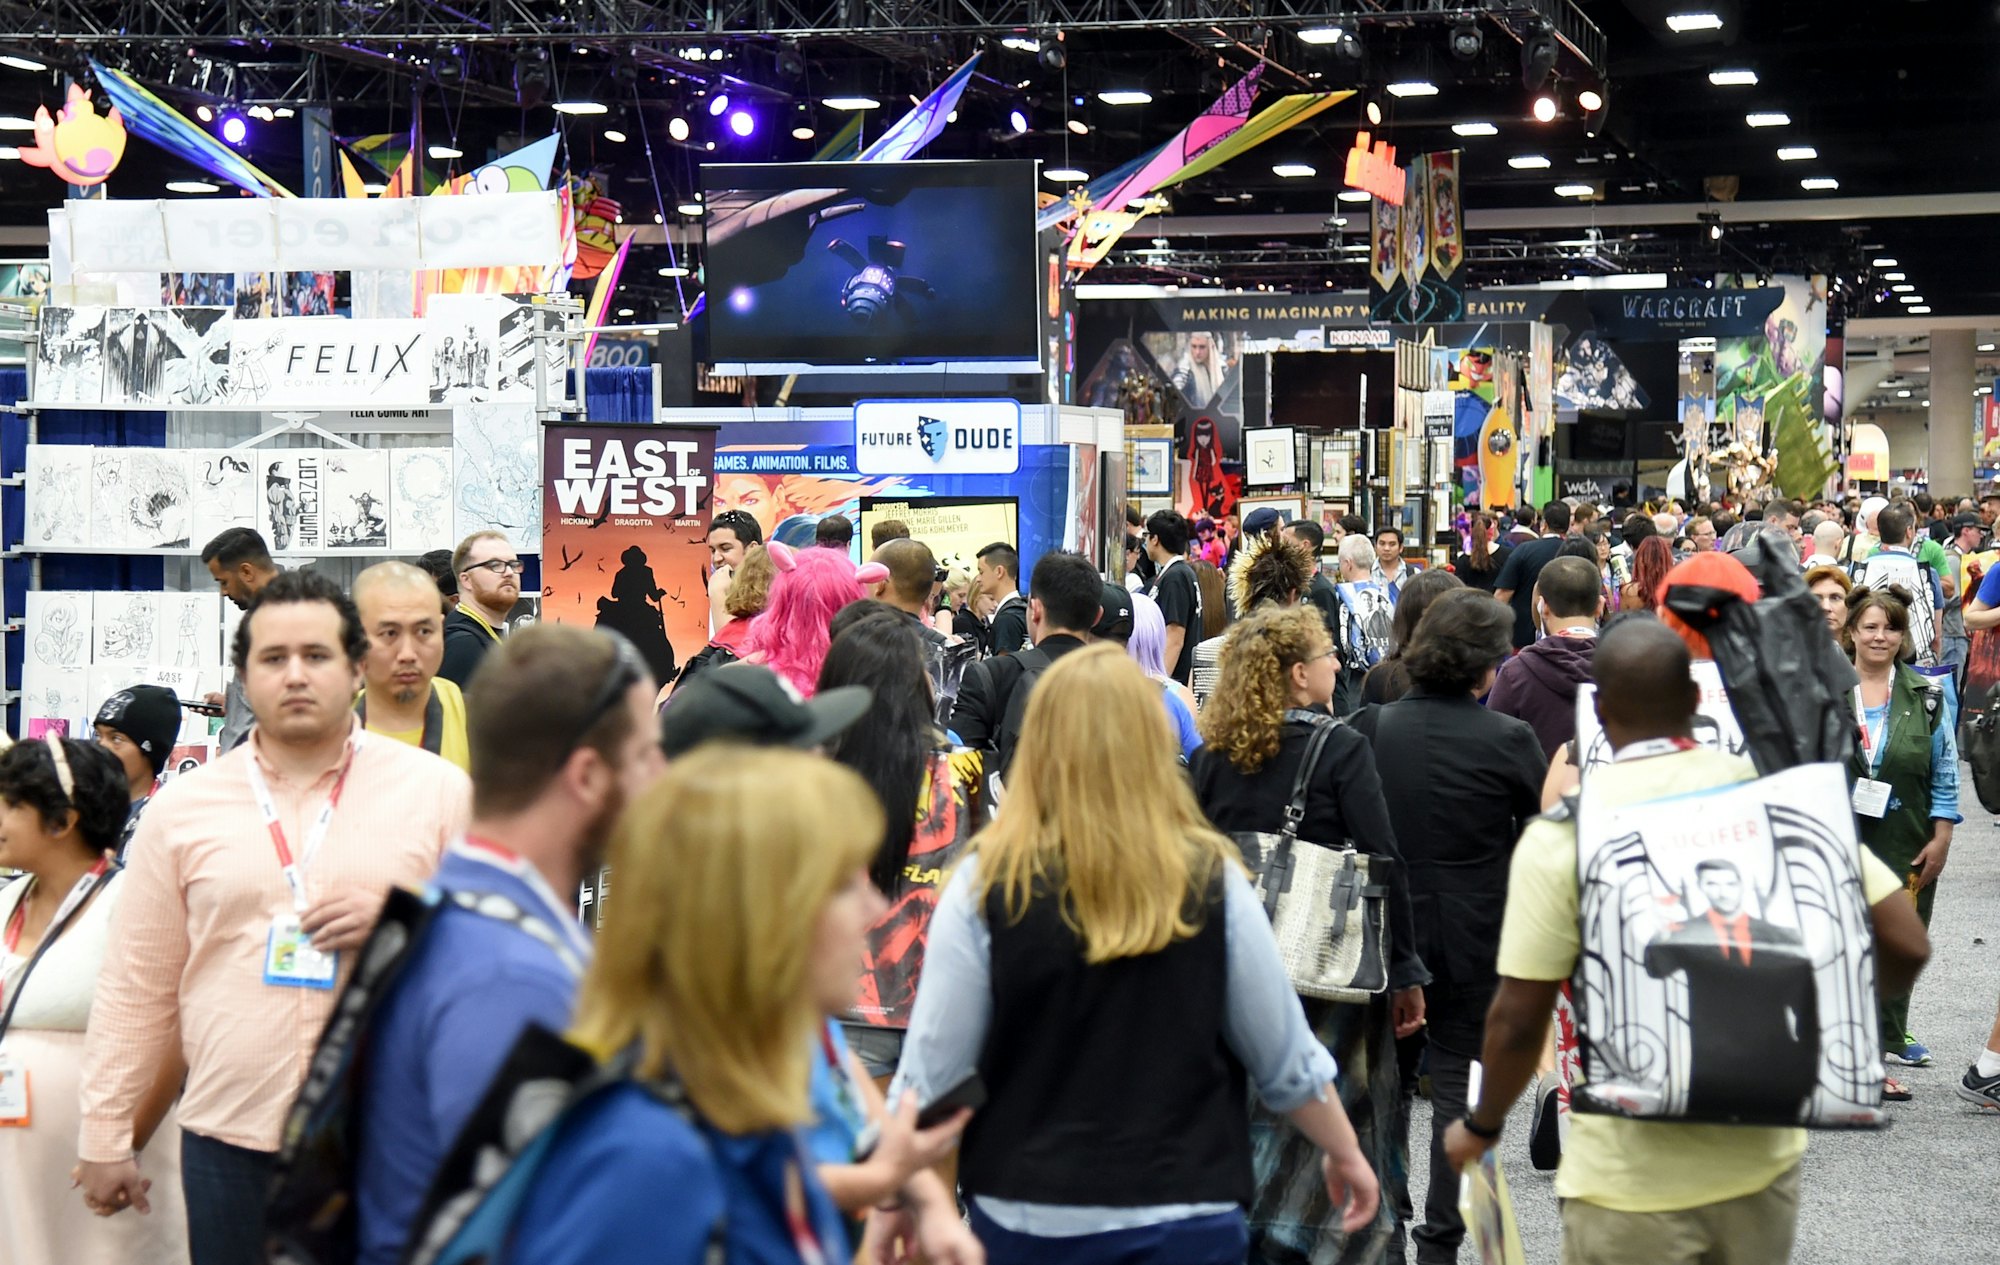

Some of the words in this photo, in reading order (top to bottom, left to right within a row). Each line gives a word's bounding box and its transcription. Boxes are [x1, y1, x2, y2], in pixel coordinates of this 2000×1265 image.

[1183, 307, 1249, 320] MAKING
[1257, 305, 1352, 319] IMAGINARY
[1468, 301, 1527, 314] EALITY
[1623, 295, 1746, 319] WARCRAFT
[1330, 331, 1390, 346] KONAMI
[287, 333, 421, 394] FELIX
[862, 432, 912, 446] FUTURE
[955, 427, 1012, 449] DUDE
[563, 438, 699, 479] EAST
[752, 455, 811, 471] ANIMATION.
[814, 455, 850, 471] FILMS.
[688, 468, 701, 477] OF
[554, 475, 708, 516] WEST
[560, 517, 595, 526] HICKMAN
[614, 518, 654, 527] DRAGOTTA
[674, 519, 701, 527] MARTIN
